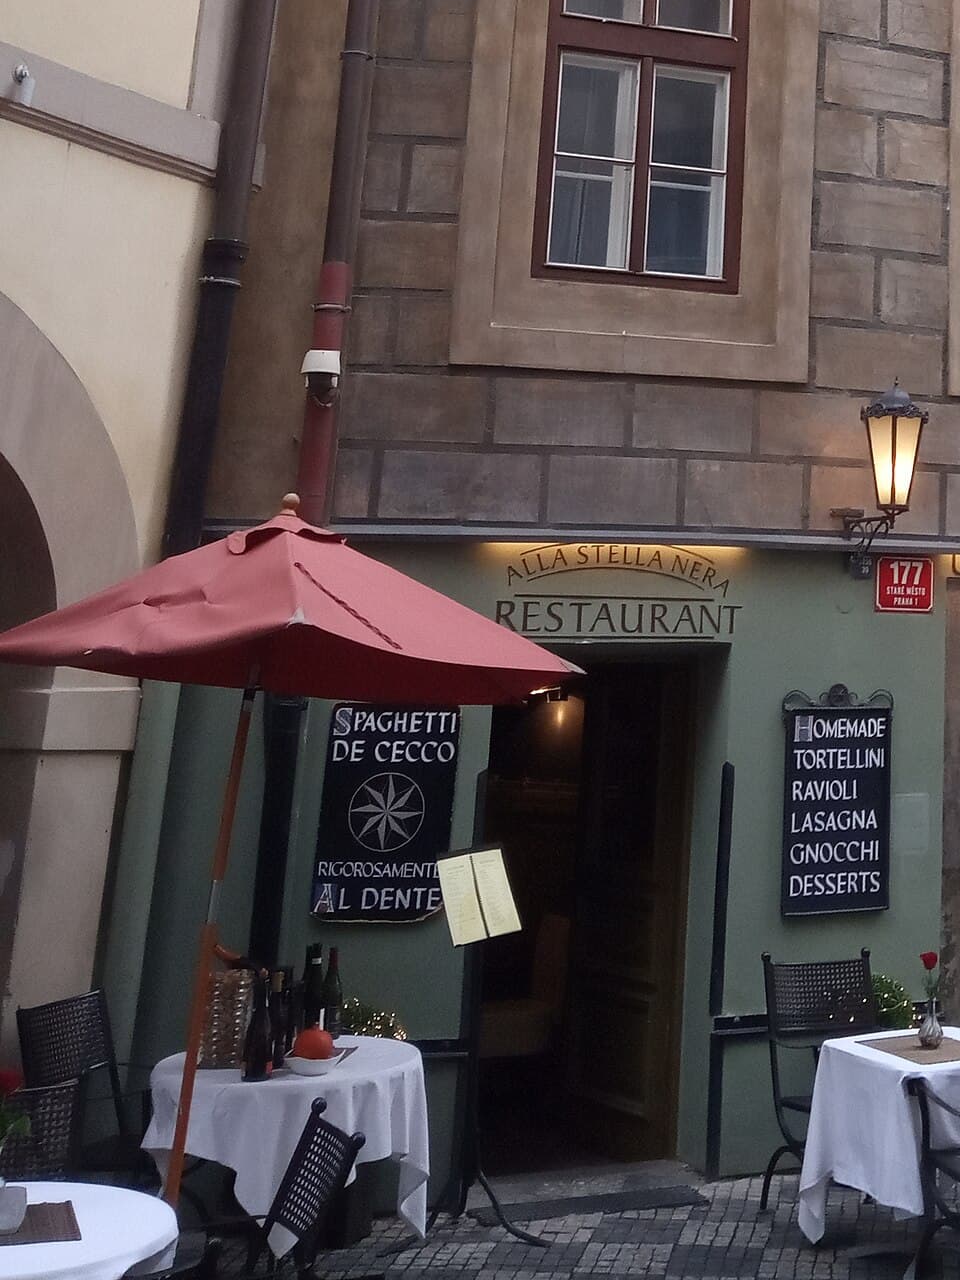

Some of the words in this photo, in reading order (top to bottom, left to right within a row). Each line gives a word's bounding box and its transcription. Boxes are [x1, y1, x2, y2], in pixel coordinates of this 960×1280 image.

[507, 548, 567, 586] ALLA
[576, 544, 663, 569] STELLA
[671, 554, 730, 598] NERA
[890, 560, 924, 585] 177
[893, 596, 913, 606] PRAHA
[914, 598, 919, 606] 1
[496, 600, 743, 635] RESTAURANT
[333, 707, 457, 736] SPAGHETTI
[794, 715, 886, 742] HOMEMADE
[332, 739, 366, 762] DE
[374, 740, 455, 763] CECCO
[793, 748, 885, 769] TORTELLINI
[792, 779, 858, 801] RAVIOLI
[790, 809, 878, 833] LASAGNA
[790, 840, 880, 865] GNOCCHI
[789, 871, 880, 897] DESSERTS
[313, 883, 351, 913] AL
[361, 887, 441, 910] DENTE
